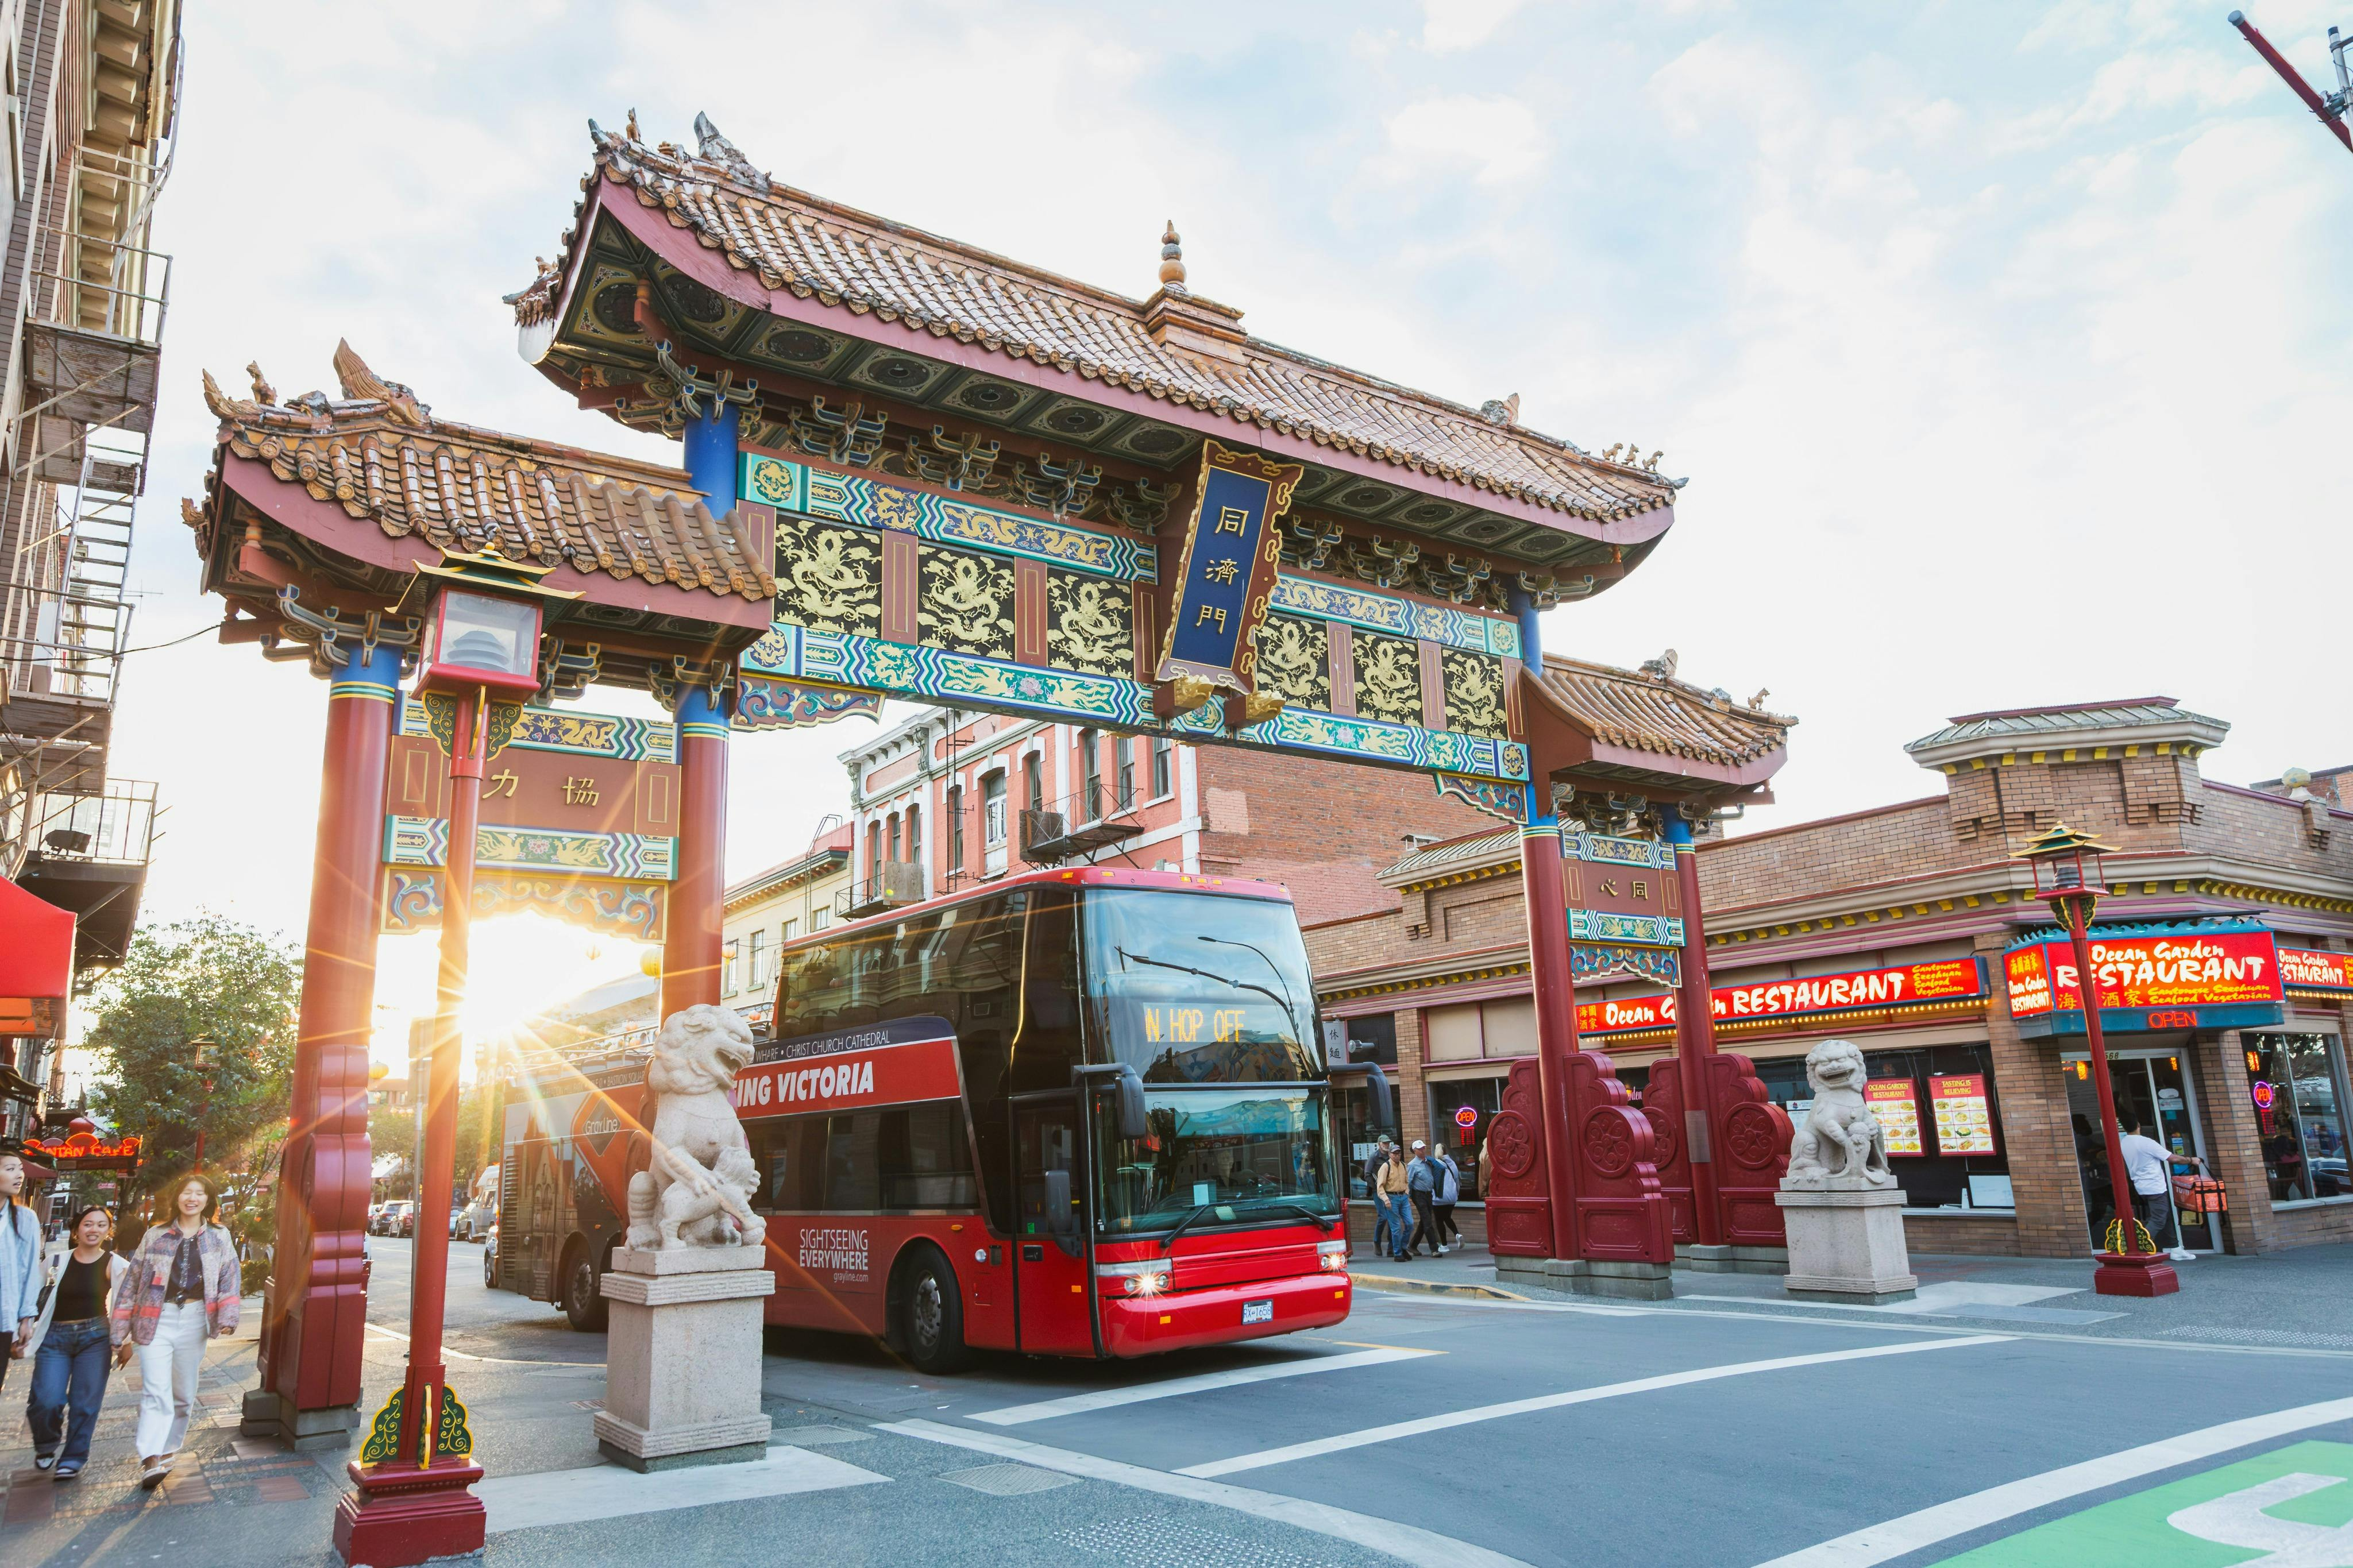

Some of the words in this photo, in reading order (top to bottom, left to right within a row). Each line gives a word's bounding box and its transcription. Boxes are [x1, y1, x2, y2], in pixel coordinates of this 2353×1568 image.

[1195, 505, 1249, 634] 同濟門
[2092, 945, 2147, 962] Ocean
[2154, 940, 2224, 961] Garden
[2278, 949, 2301, 964] Ocean
[2302, 952, 2329, 967] Garden
[1912, 963, 1961, 973] Cantonese
[1913, 971, 1962, 981] Szechuan
[2278, 963, 2343, 985] STAURANT
[1914, 978, 1950, 988] Seafood
[1915, 986, 1964, 997] Vegetarian
[2147, 987, 2209, 995] Cantonese
[2213, 984, 2269, 993] Szechuan
[1732, 972, 1905, 1014] RESTAURANT
[2011, 991, 2049, 1012] RESTAURANT
[2059, 989, 2144, 1010] 海酒家
[2149, 994, 2198, 1005] Seafood
[2204, 992, 2271, 1002] Vegetarian
[1606, 1003, 1654, 1026] Ocean
[2148, 1011, 2197, 1029] OPEN
[1145, 1008, 1159, 1042] N
[1170, 1009, 1203, 1042] HOP
[1214, 1010, 1245, 1043] OFF
[755, 1048, 778, 1062] WHARF
[786, 1042, 811, 1058] CHRIST
[812, 1038, 843, 1055] CHURCH
[846, 1030, 890, 1049] CATHEDRAL
[628, 1070, 645, 1084] SQUAR
[777, 1061, 874, 1103] VICTORIA
[2256, 1088, 2271, 1101] OPEN
[604, 1117, 618, 1131] Line
[1457, 1111, 1475, 1122] OPEN
[800, 1229, 868, 1250] SIGHTSEEING
[800, 1249, 868, 1270] EVERYWHERE
[834, 1270, 869, 1283] grayline.com
